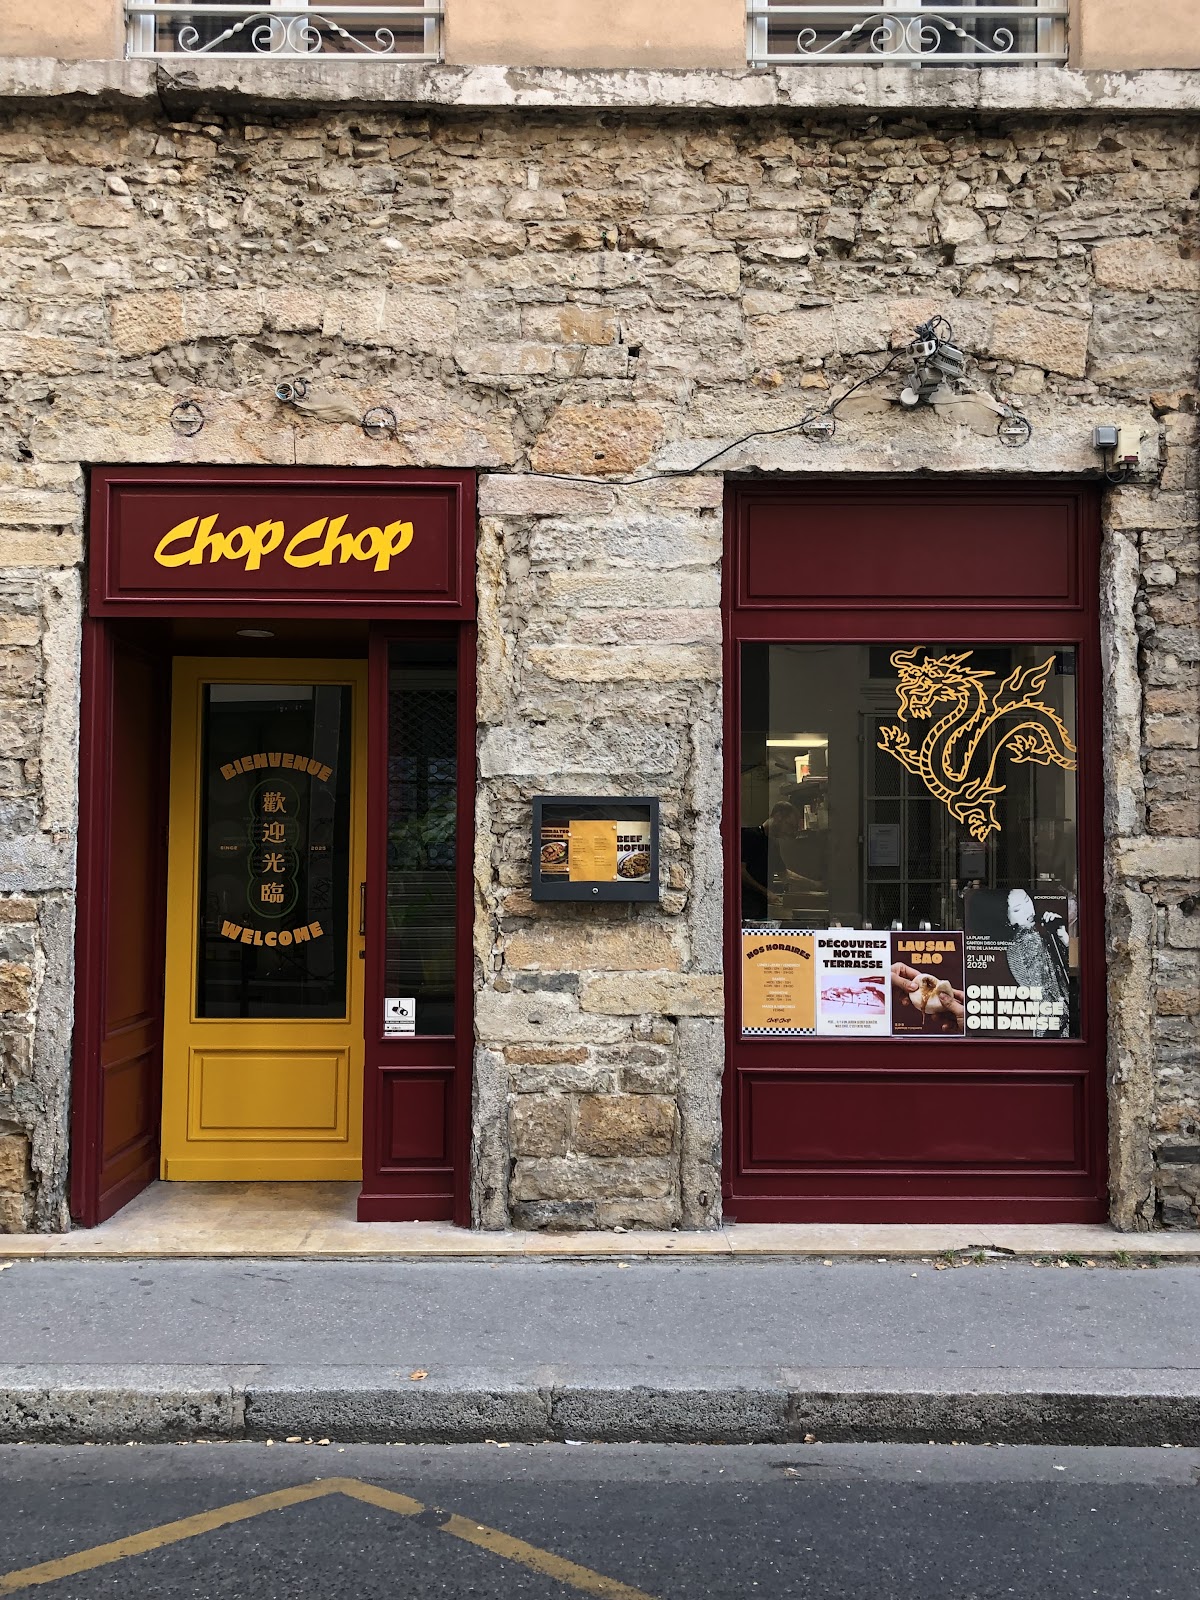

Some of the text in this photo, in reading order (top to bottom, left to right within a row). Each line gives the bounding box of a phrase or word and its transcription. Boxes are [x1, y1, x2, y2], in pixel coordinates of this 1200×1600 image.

[153, 513, 414, 573] Chop Chop
[219, 752, 334, 783] BIENVENUE
[617, 835, 643, 843] BEEF
[261, 791, 287, 904] 歡迎光臨
[220, 919, 324, 947] WELCOME
[818, 938, 887, 949] DÉCOUVREZ
[897, 940, 957, 952] LAUSAA
[746, 943, 811, 960] NOS HORAIRES
[833, 950, 873, 959] NOTRE
[823, 959, 884, 969] TERRASSE
[911, 953, 943, 965] BAO
[966, 954, 995, 963] 21 JUIN
[966, 961, 988, 969] 2025
[966, 985, 1043, 1000] ON WOK
[966, 1000, 1064, 1015] ON MANGE
[966, 1015, 1060, 1031] ON DANSE
